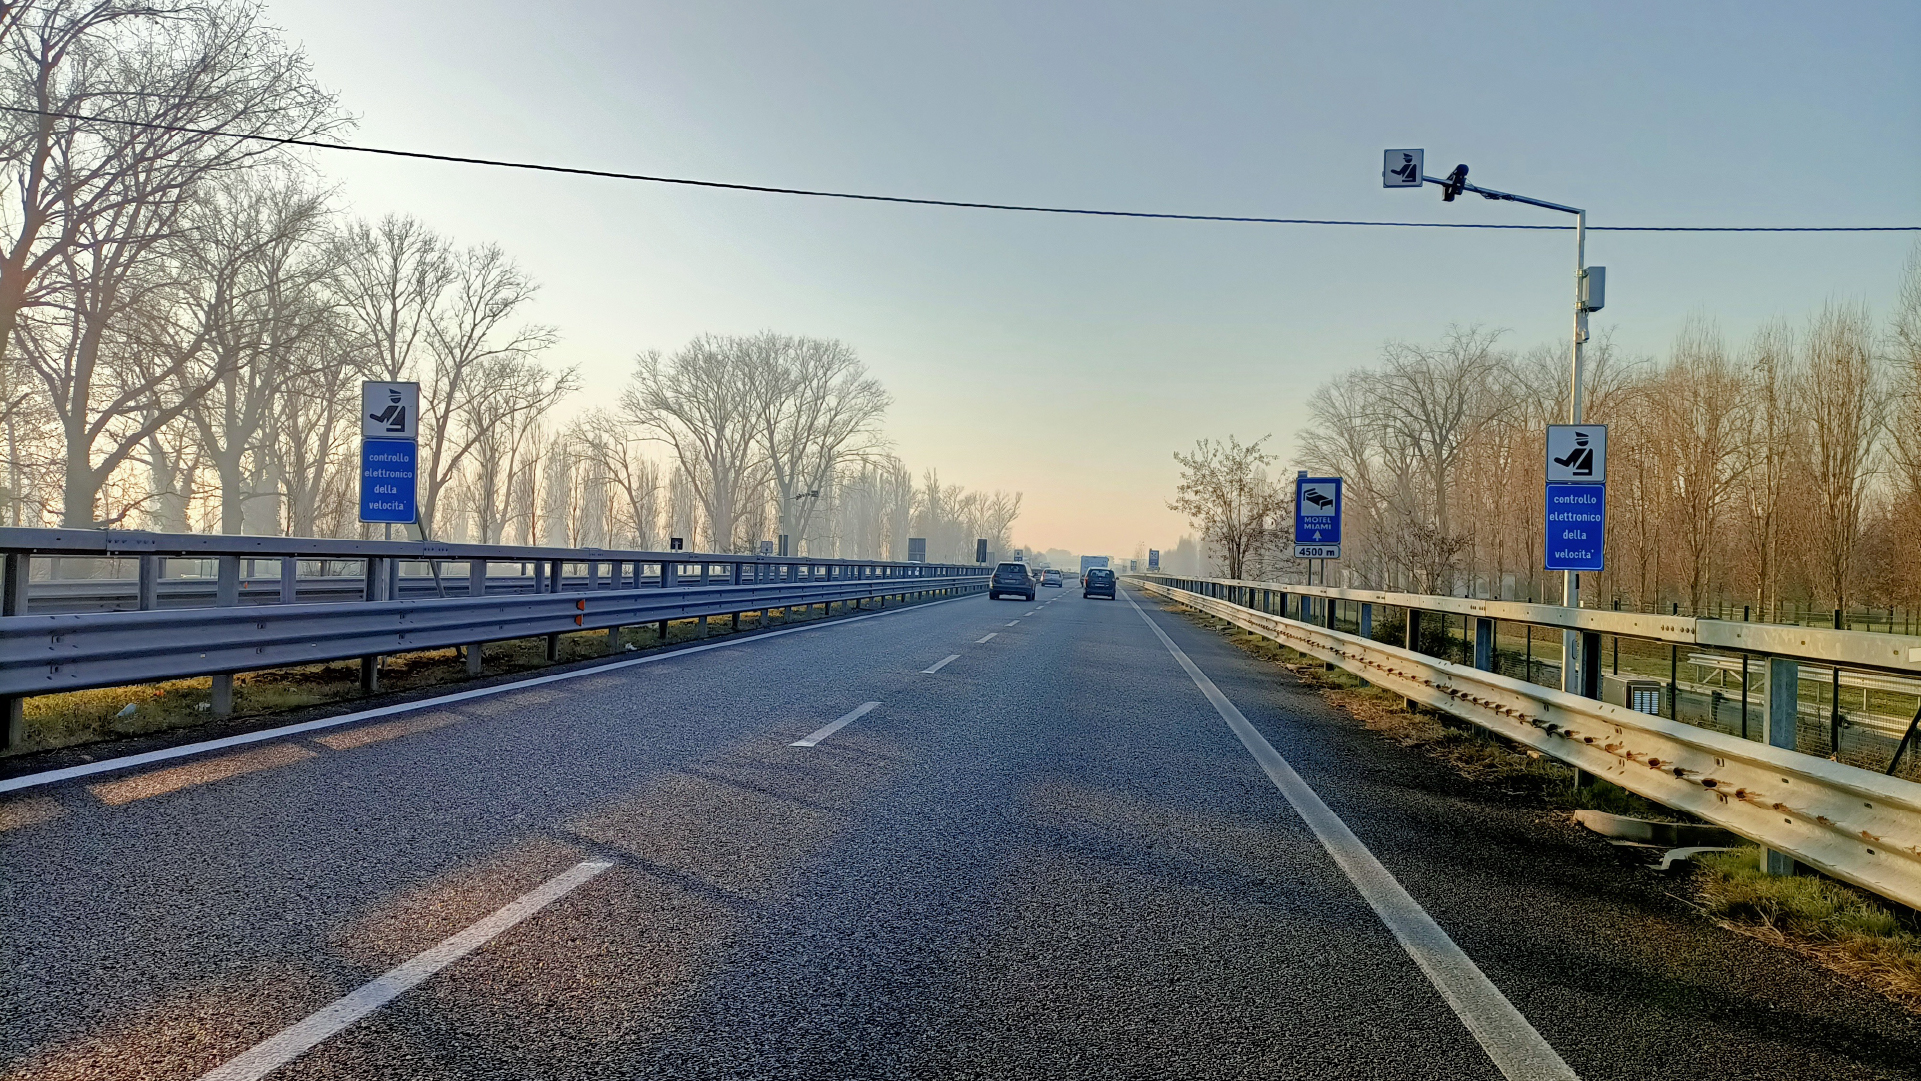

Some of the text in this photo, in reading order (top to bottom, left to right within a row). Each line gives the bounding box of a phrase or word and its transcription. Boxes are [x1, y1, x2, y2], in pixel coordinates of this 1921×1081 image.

[369, 453, 409, 462] controllo
[364, 468, 413, 478] elettronico
[374, 484, 397, 494] della
[1553, 494, 1597, 504] controllo
[1549, 511, 1601, 522] elettronico
[1562, 529, 1587, 539] della
[1299, 547, 1323, 556] 4500
